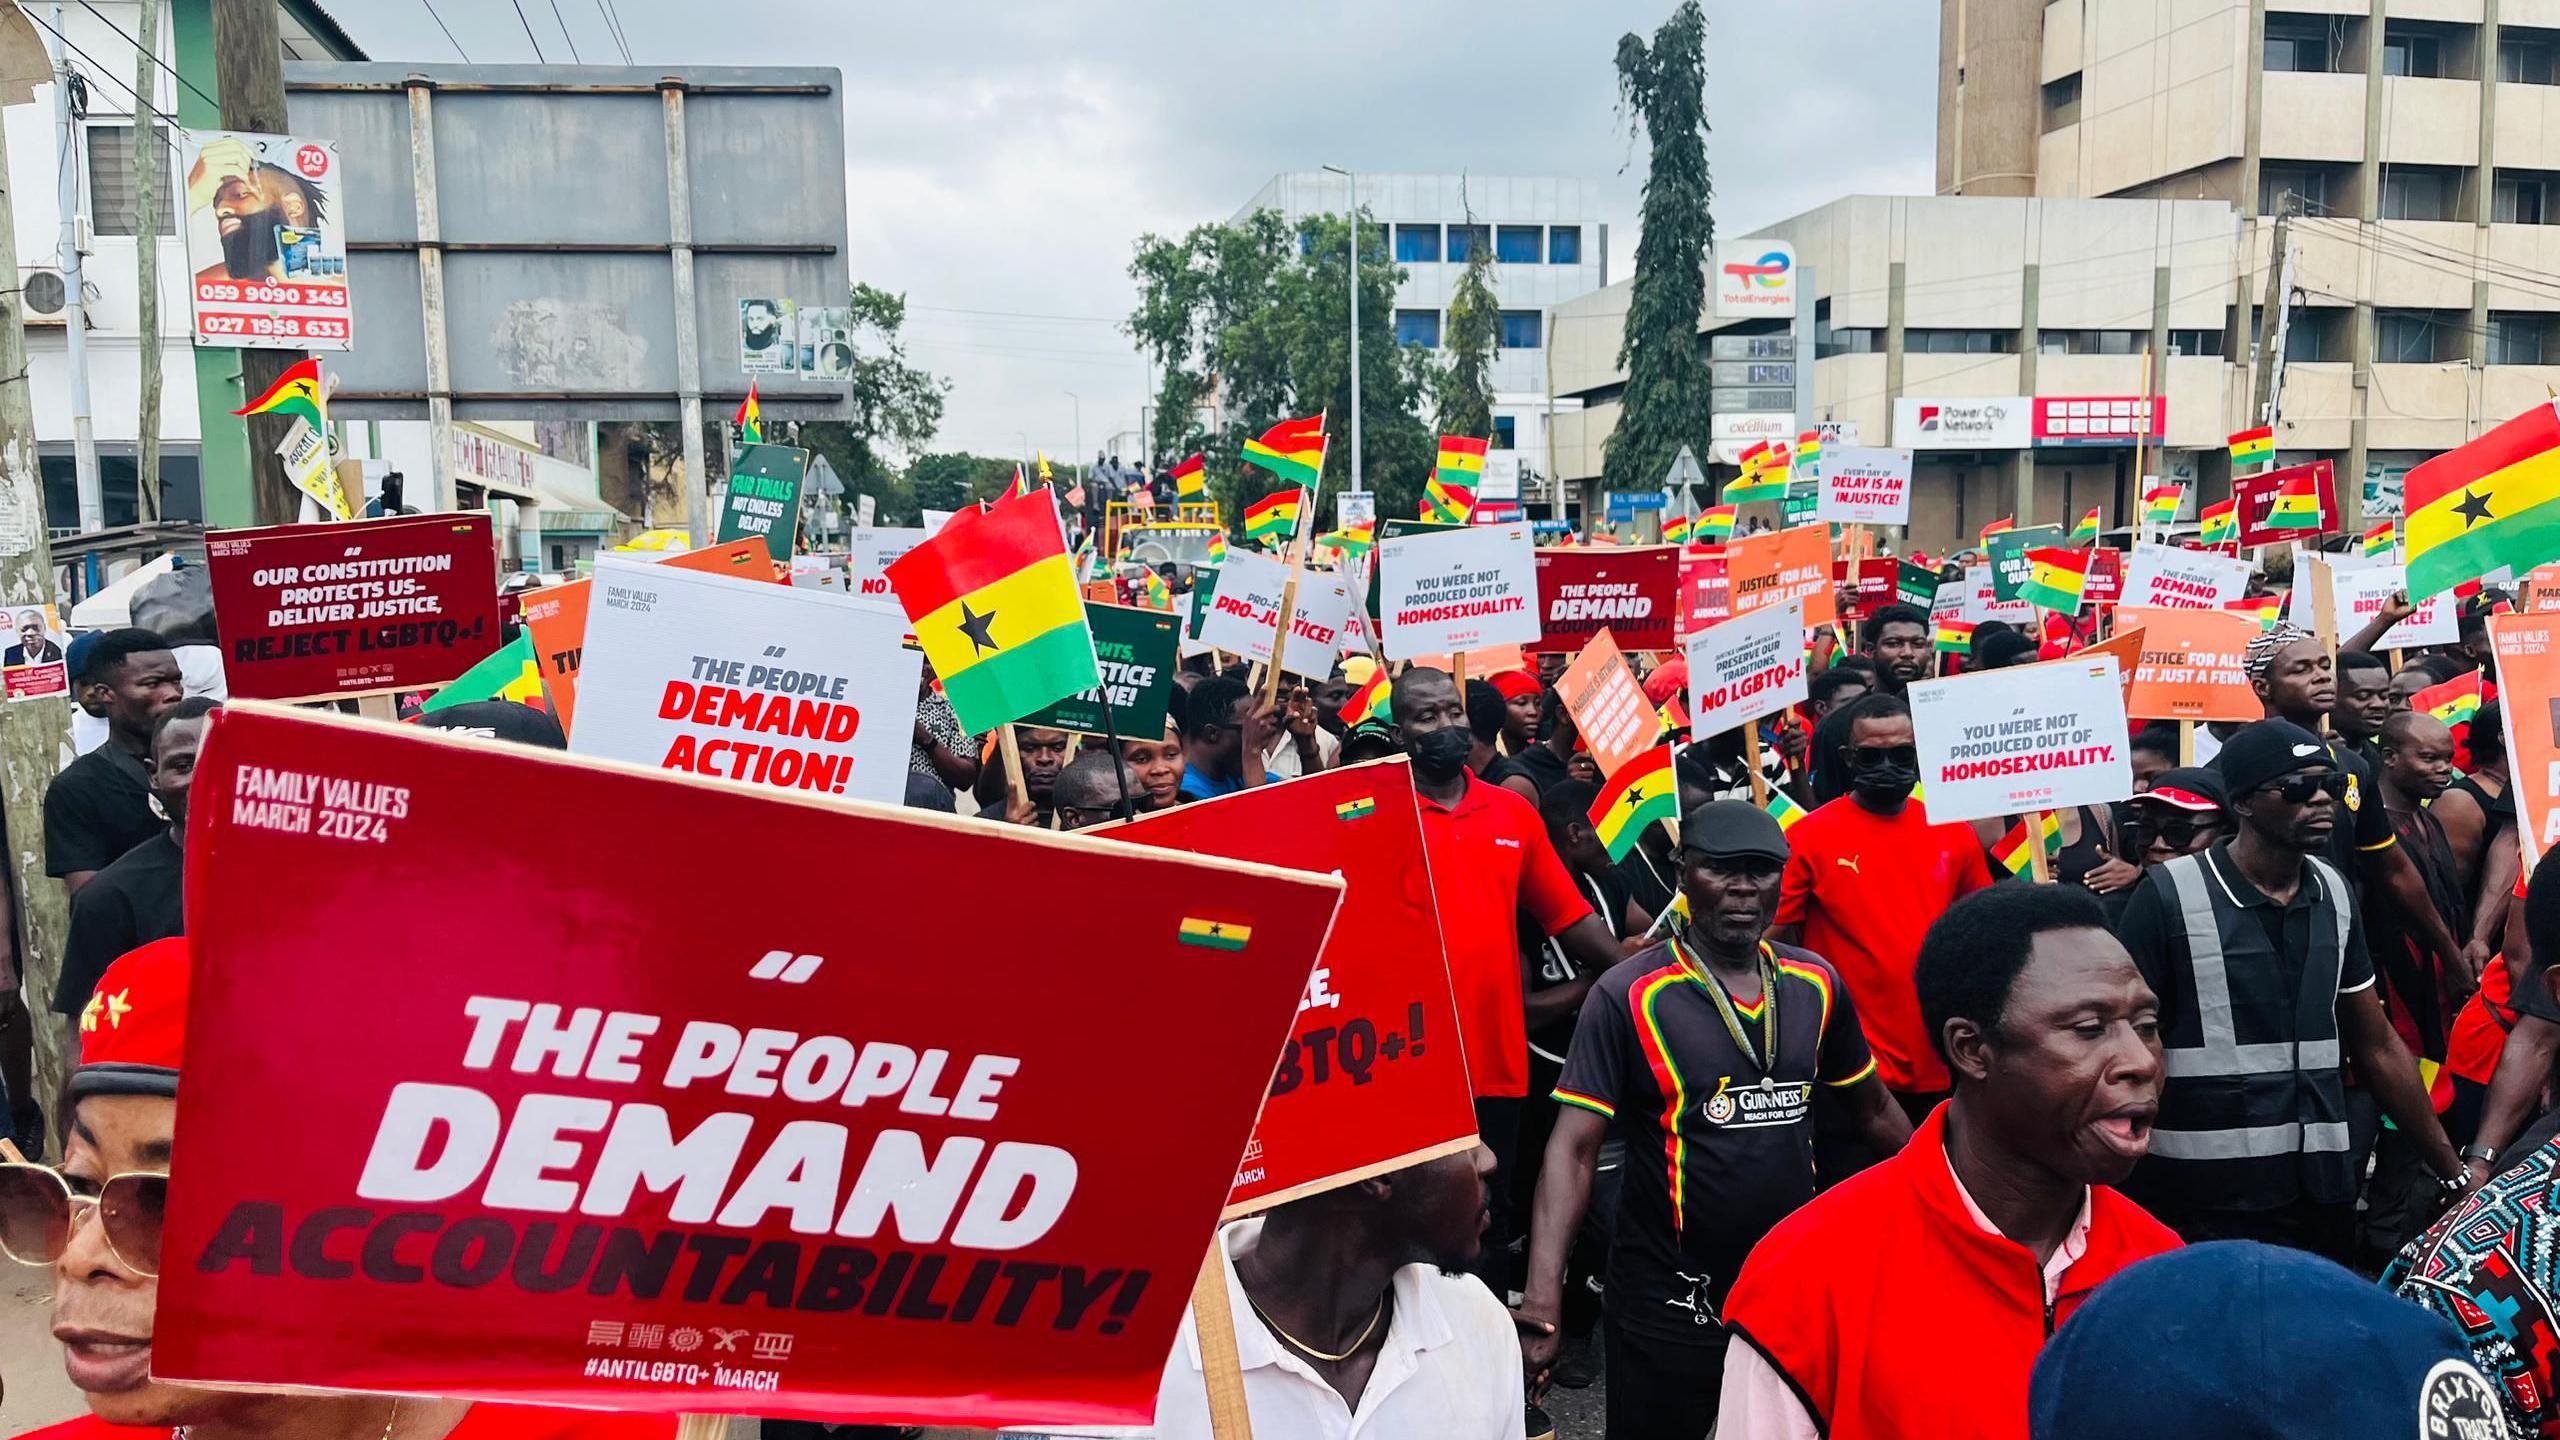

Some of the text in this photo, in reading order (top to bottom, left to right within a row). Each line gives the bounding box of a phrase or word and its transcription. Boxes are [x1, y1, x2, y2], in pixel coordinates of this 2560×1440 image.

[301, 150, 324, 164] 70
[201, 285, 344, 305] 059 9090 345
[1723, 294, 1791, 305] TotalEnergies
[205, 317, 344, 336] 027 1958 633
[1944, 406, 2007, 419] Power City
[1729, 420, 1782, 433] excellium
[1944, 419, 1993, 431] Network
[1843, 468, 1865, 476] EVERY
[1866, 468, 1881, 477] DAY
[731, 475, 794, 500] FAIR TRIALS
[1832, 476, 1903, 491] DELAY IS AN
[731, 496, 784, 518] NOT ENDLESS
[1835, 492, 1900, 505] INJUSTICE!
[738, 514, 772, 534] DELAYS!
[1175, 529, 1201, 537] FAITH
[253, 554, 451, 588] OUR CONSTITUTION
[2000, 559, 2021, 573] OUR
[861, 579, 887, 594] NO
[1416, 570, 1500, 591] YOU WERE NOT
[1737, 564, 1823, 594] JUSTICE FOR ALL,
[2162, 569, 2214, 585] THE PEOPLE
[281, 581, 383, 607] PROTECTS
[607, 586, 658, 604] FAMILY VALUES
[1405, 583, 1510, 607] PRODUCED OUT OF
[1560, 583, 1638, 598] THE PEOPLE
[1736, 586, 1796, 611] NOT JUST A
[2151, 577, 2217, 599] DEMAND
[2358, 590, 2380, 600] THIS
[268, 595, 443, 628] DELIVER JUSTICE,
[606, 597, 651, 612] MARCH 2024
[1397, 596, 1525, 626] HOMOSEXUALITY.
[1550, 597, 1652, 621] DEMAND
[235, 616, 485, 664] REJECT LGBTQ+!
[2523, 630, 2549, 642] VALUES
[1716, 640, 1780, 673] PRESERVE OUR
[1735, 643, 1754, 653] UNDER
[2524, 643, 2545, 654] 2024
[2187, 653, 2215, 666] FOR
[691, 656, 849, 700] THE PEOPLE
[1701, 658, 1801, 714] NO LGBTQ+!
[2157, 669, 2195, 684] JUST
[2196, 670, 2208, 683] A
[658, 680, 860, 743] DEMAND
[1963, 713, 2078, 741] YOU WERE NOT
[1950, 729, 2092, 760] PRODUCED OUT OF
[662, 735, 855, 795] ACTION!
[1941, 745, 2115, 783] HOMOSEXUALITY.
[235, 765, 411, 819] FAMILY VALUES
[232, 799, 388, 843] MARCH 2024
[462, 996, 1020, 1121] THE PEOPLE
[1739, 1089, 1801, 1110] GUINNESS
[1744, 1110, 1784, 1121] REACH FOR
[357, 1081, 1079, 1250] DEMAND
[199, 1203, 1151, 1335] ACCOUNTABILITY!
[584, 1357, 780, 1392] #ANTILGBTQ+ MARCH
